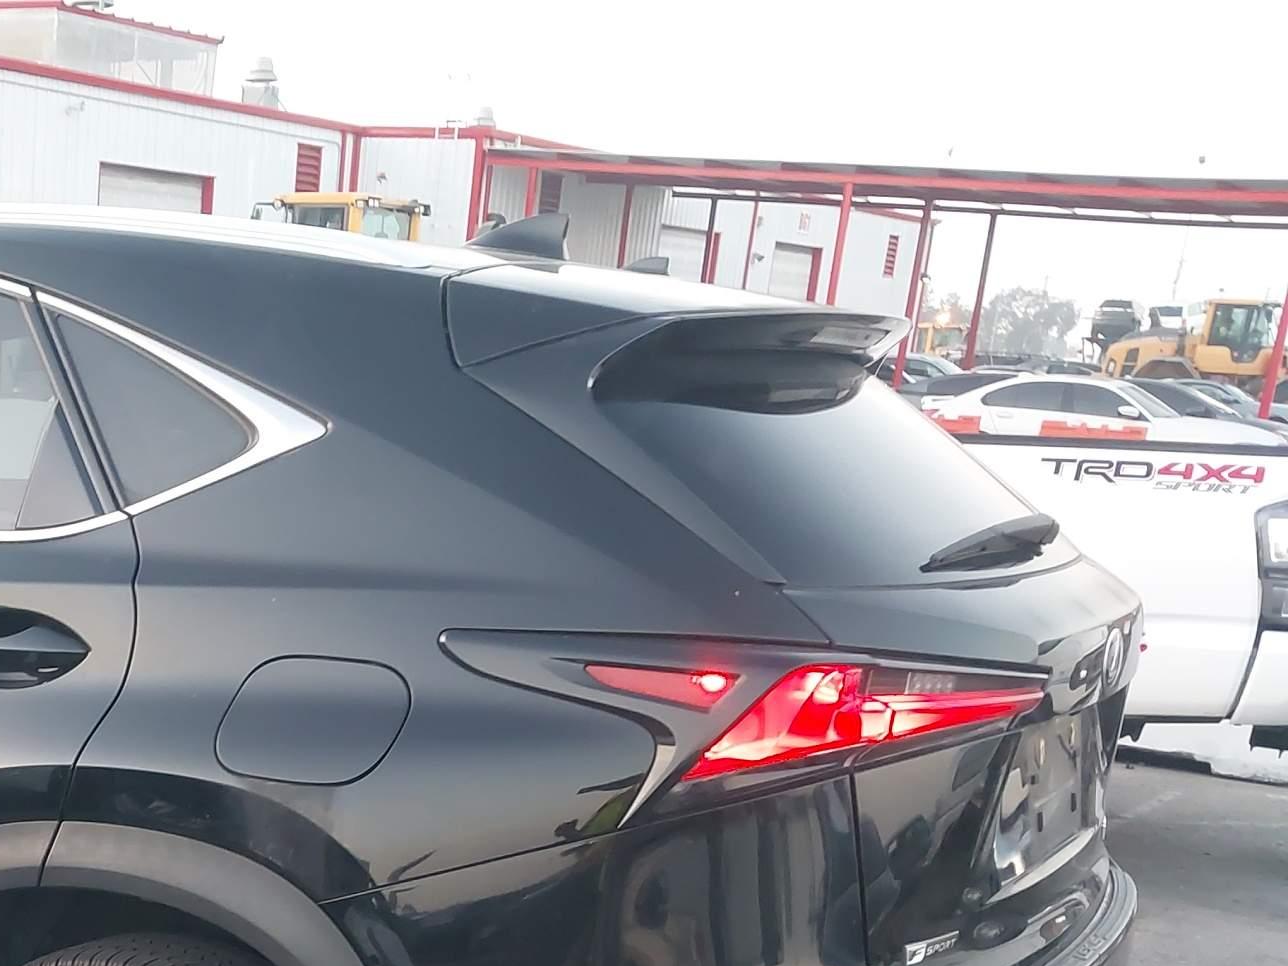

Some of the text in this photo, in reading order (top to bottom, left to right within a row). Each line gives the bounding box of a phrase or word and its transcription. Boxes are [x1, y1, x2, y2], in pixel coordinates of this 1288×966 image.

[1041, 457, 1154, 484] TRD
[1152, 480, 1259, 495] SPORT
[925, 937, 957, 957] SPORT
